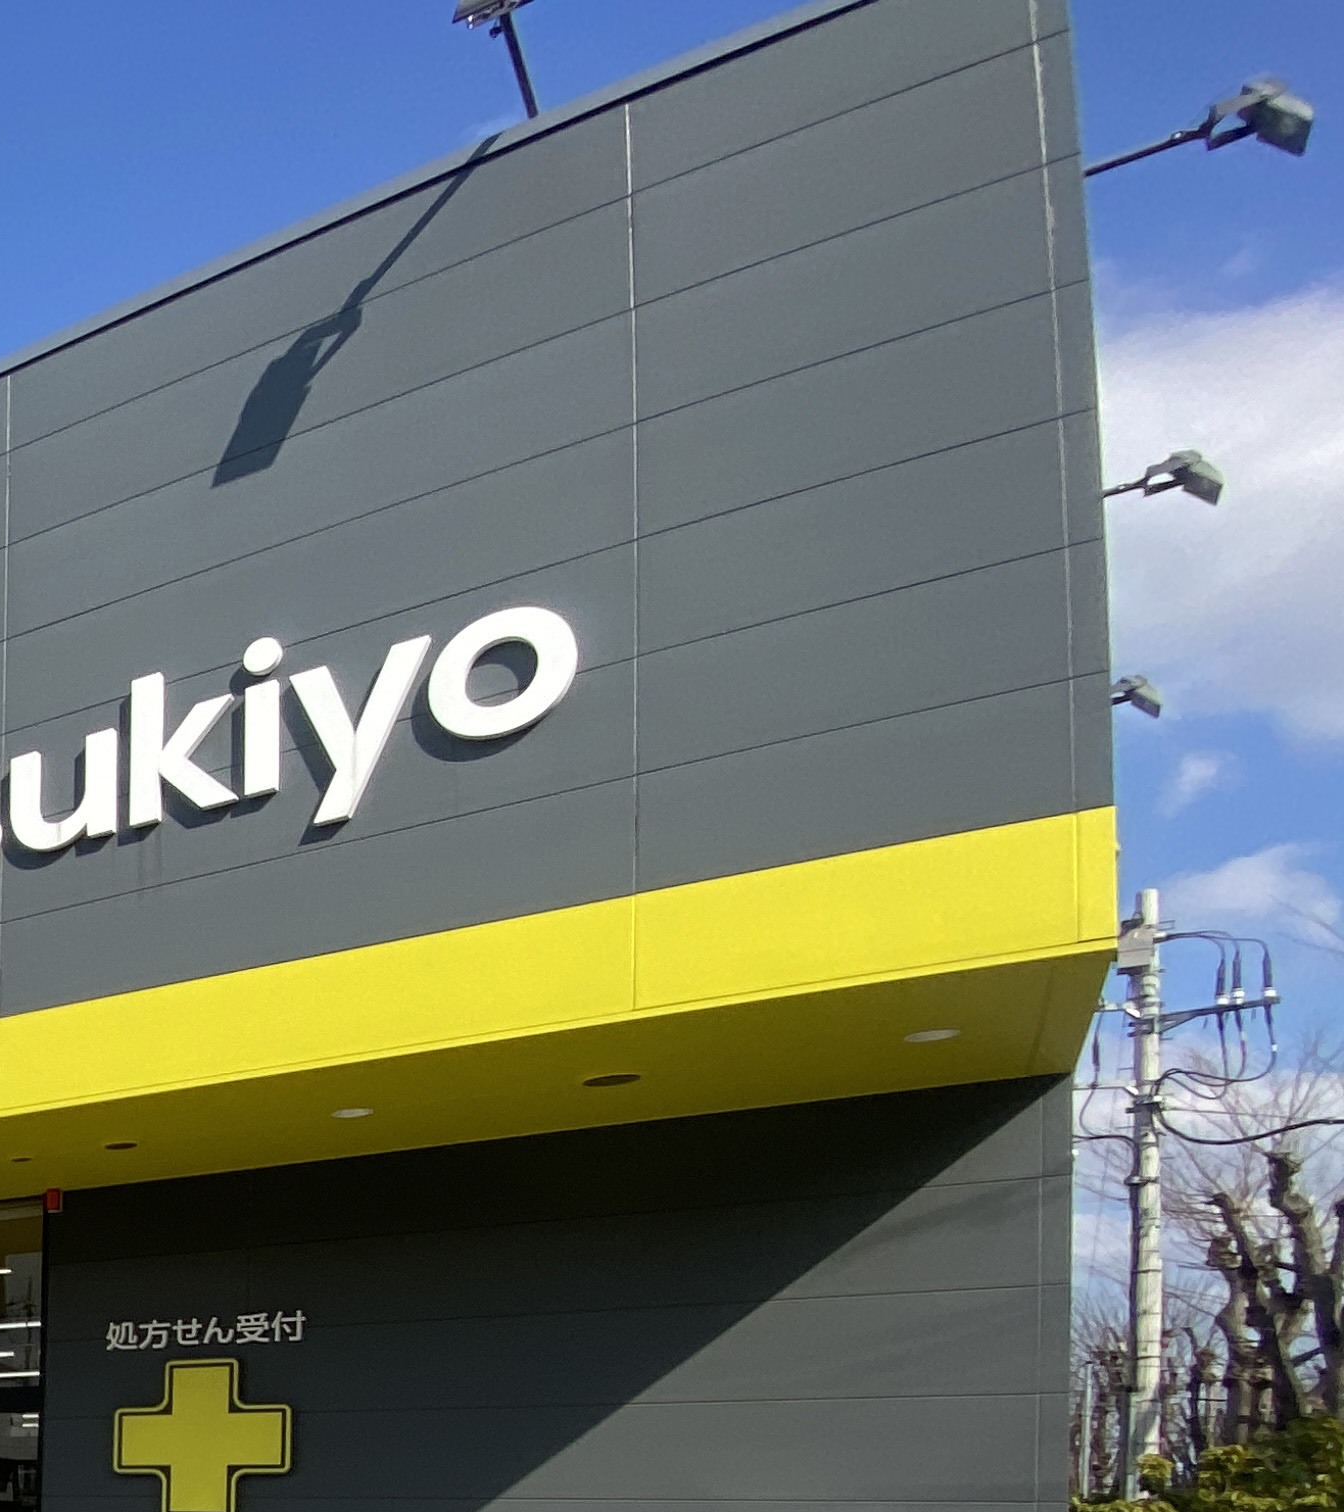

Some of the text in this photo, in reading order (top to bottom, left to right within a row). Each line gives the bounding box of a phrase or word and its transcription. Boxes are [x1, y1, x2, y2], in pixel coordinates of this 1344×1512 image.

[105, 1309, 307, 1351] 処方せん受付
